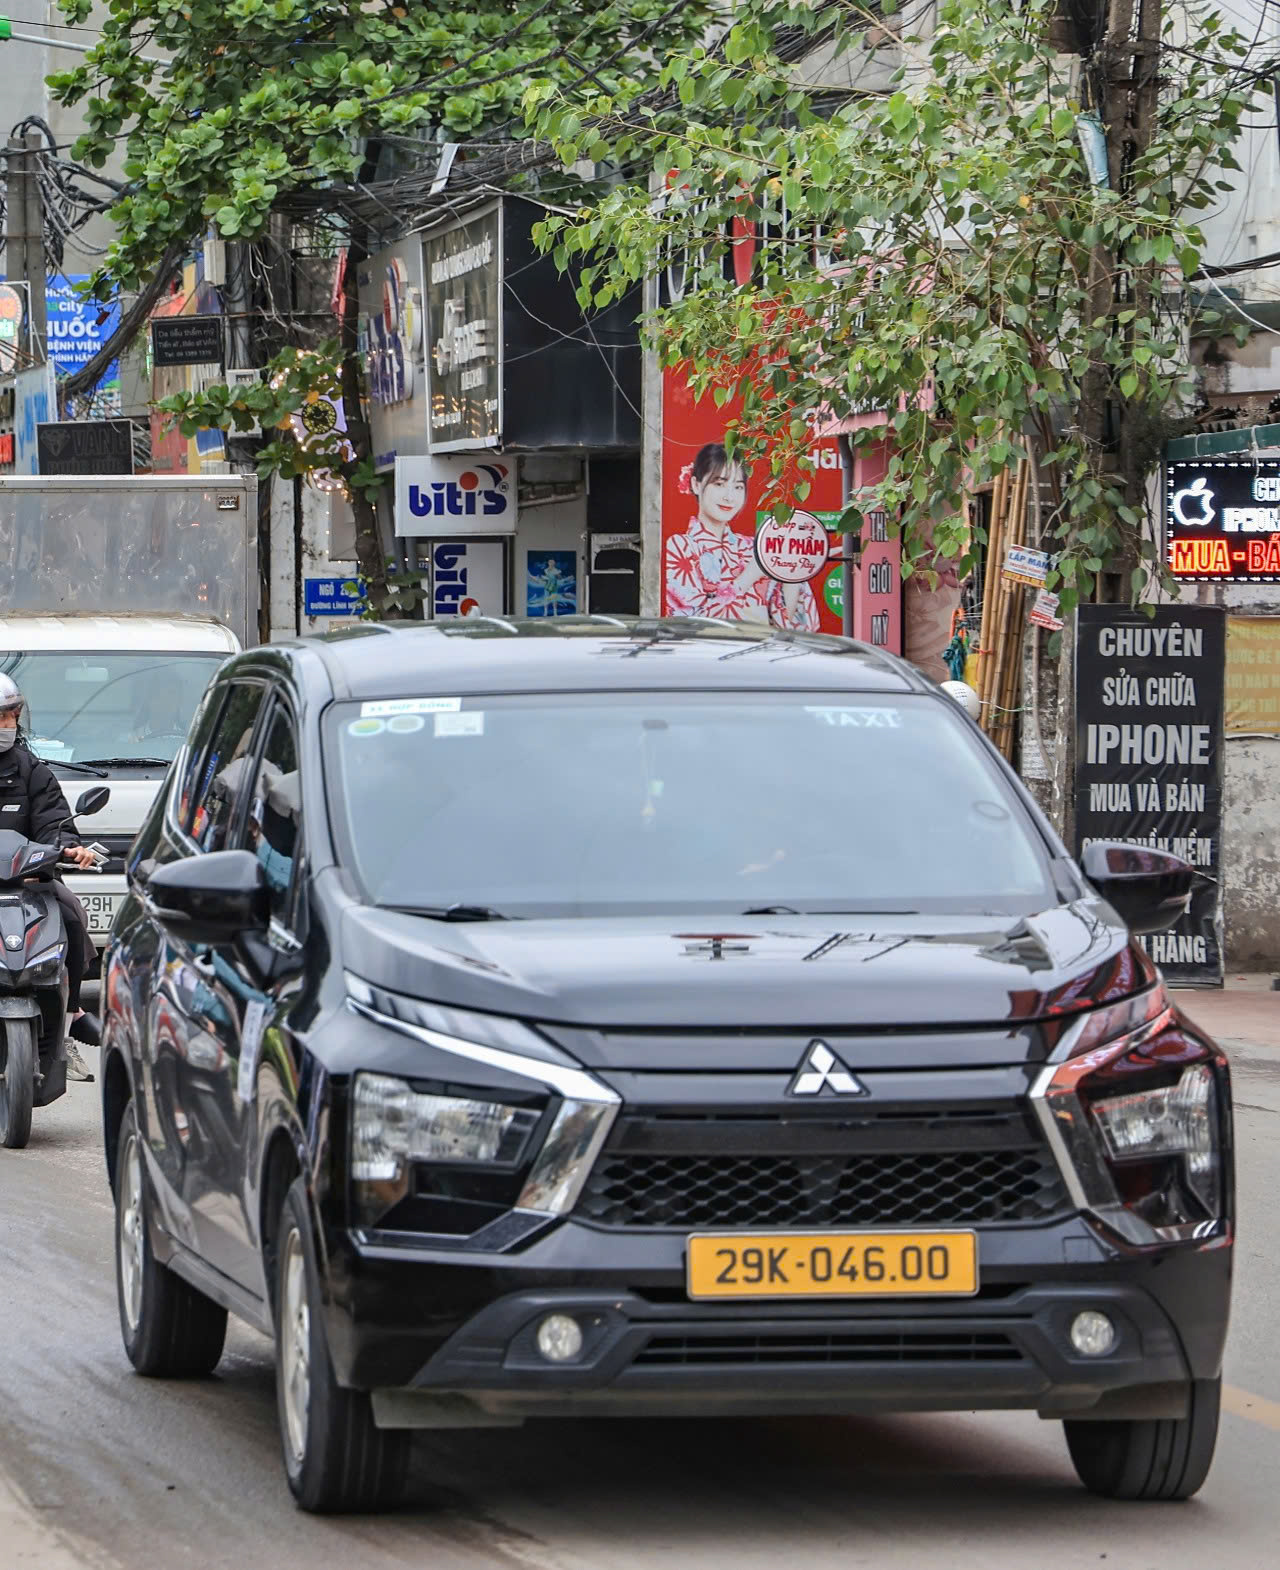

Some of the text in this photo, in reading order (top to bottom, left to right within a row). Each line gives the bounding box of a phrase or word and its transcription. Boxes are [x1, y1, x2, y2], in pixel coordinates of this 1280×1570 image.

[869, 559, 892, 593] GIỚI
[1099, 622, 1203, 657] CHUYÊN
[1102, 667, 1140, 707] SỬA
[1145, 672, 1196, 707] CHỮA
[1086, 724, 1211, 765] IPHONE
[1090, 777, 1205, 812] MUA VÀ BÁN
[81, 896, 113, 912] 29H
[1152, 929, 1207, 963] HÃNG
[715, 1245, 950, 1284] 29K-046.00
